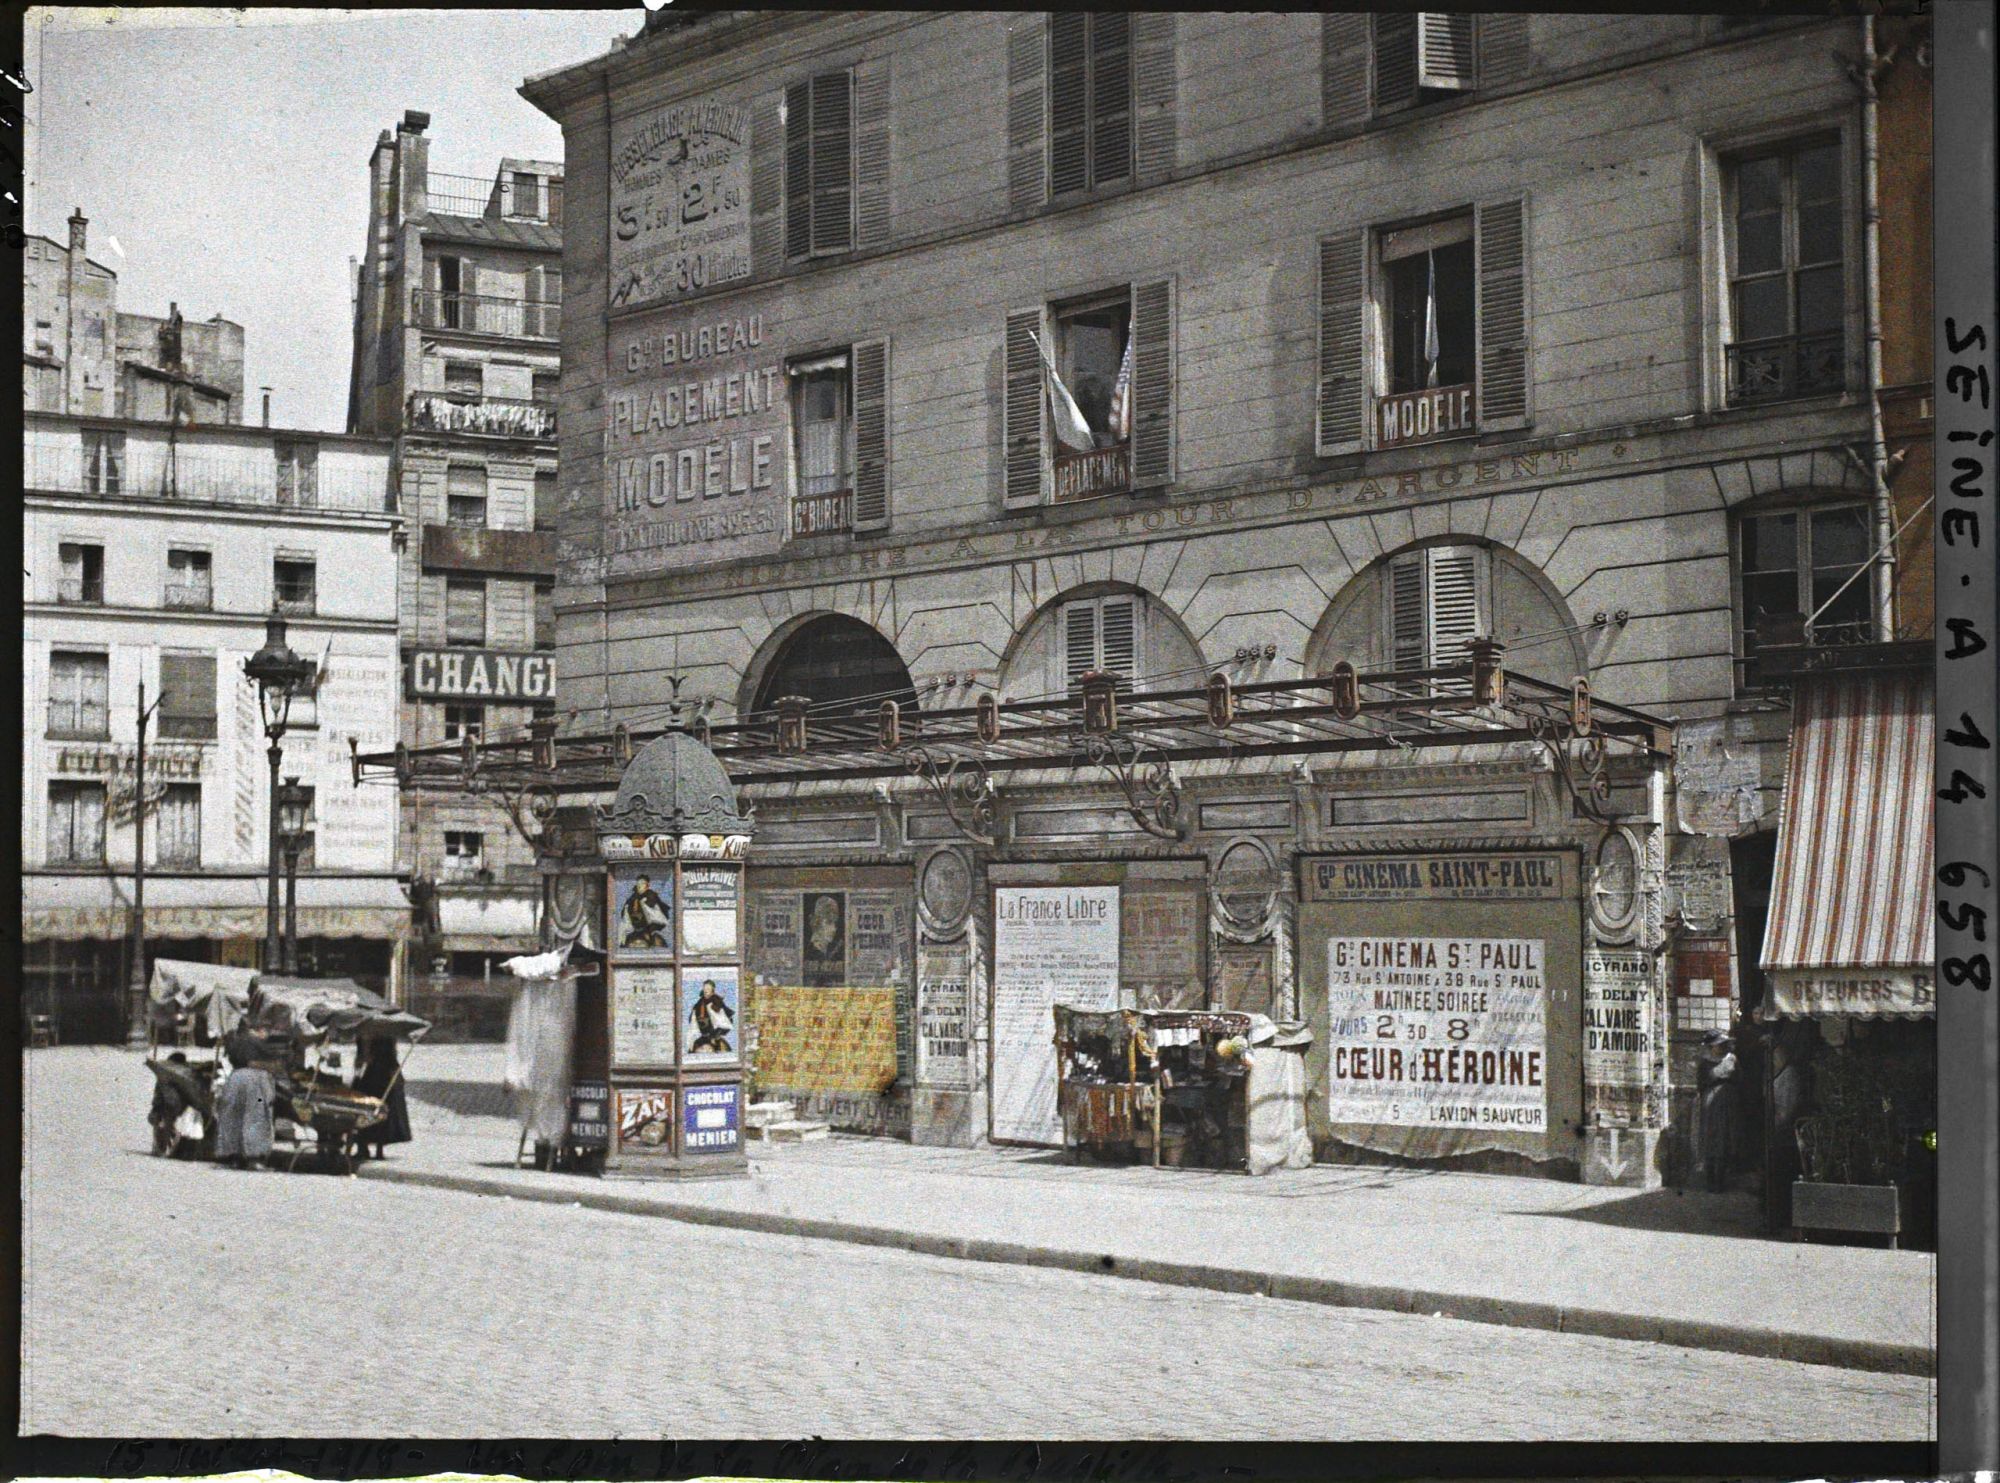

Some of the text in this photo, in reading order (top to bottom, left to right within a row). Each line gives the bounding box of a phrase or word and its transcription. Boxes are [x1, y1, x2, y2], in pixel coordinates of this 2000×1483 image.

[662, 314, 764, 366] BUREAU
[610, 364, 778, 438] PLACEMENT
[808, 494, 851, 533] BUREAU
[1013, 527, 1074, 550] LA
[1114, 500, 1236, 533] TOUR
[1938, 711, 1991, 805] 14
[648, 834, 676, 860] KUB
[721, 838, 750, 860] KUB
[1429, 860, 1553, 888] SAINT-PAUL
[999, 894, 1107, 920] La France Libre
[1937, 861, 1992, 993] 658
[1480, 943, 1537, 970] PAUL
[1592, 961, 1649, 973] CYRANO
[1333, 970, 1350, 984] 73
[1355, 972, 1372, 985] Rue
[1387, 971, 1431, 986] ANTOINE
[1444, 972, 1464, 987] 38
[1470, 974, 1489, 988] Rue
[1510, 974, 1542, 989] PAUL
[1911, 973, 1936, 1006] B
[1602, 988, 1649, 1002] DELNY
[921, 1022, 965, 1039] CALVAIRE
[1407, 1023, 1427, 1040] 30
[1588, 1030, 1649, 1053] D'AMOUR
[928, 1040, 968, 1057] D'AMOUR
[1335, 1046, 1403, 1082] CŒUR
[687, 1090, 736, 1107] CHOCOLAT
[620, 1096, 667, 1132] ZAN
[1482, 1106, 1543, 1126] SAUVEUR
[571, 1122, 608, 1138] MENIER
[685, 1129, 738, 1148] MENIER
